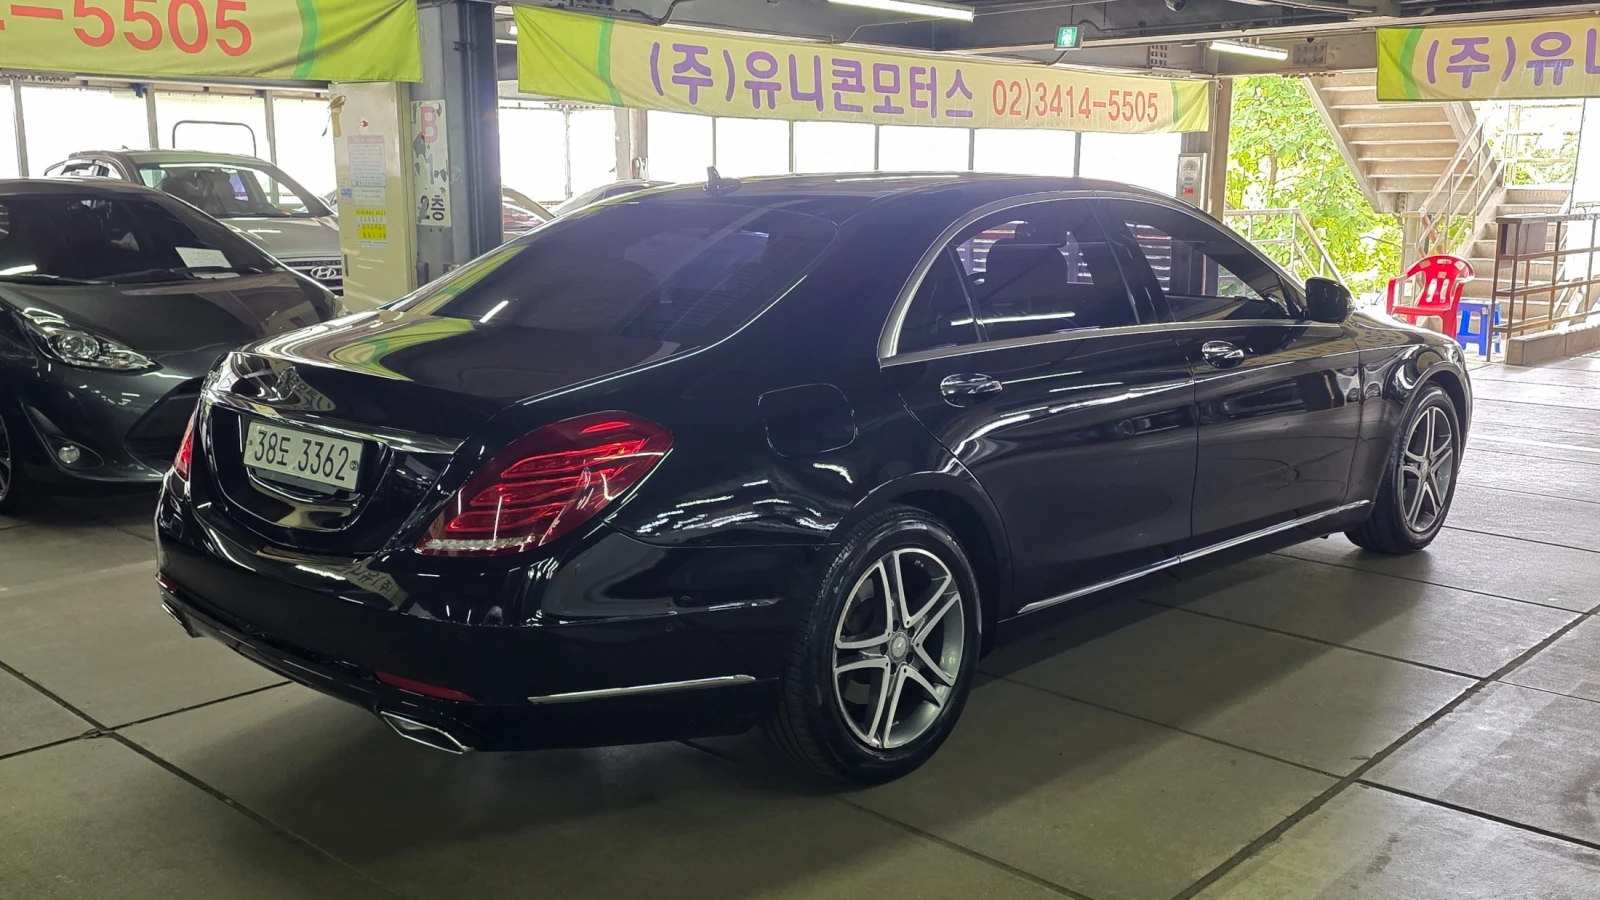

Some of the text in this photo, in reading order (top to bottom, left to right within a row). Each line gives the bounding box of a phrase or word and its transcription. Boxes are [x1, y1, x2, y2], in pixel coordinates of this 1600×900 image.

[0, 0, 252, 57] -5505
[650, 41, 975, 119] (주)유니콘모터스
[992, 78, 1159, 123] 02)3414-5505
[254, 429, 350, 482] 38도 3362
